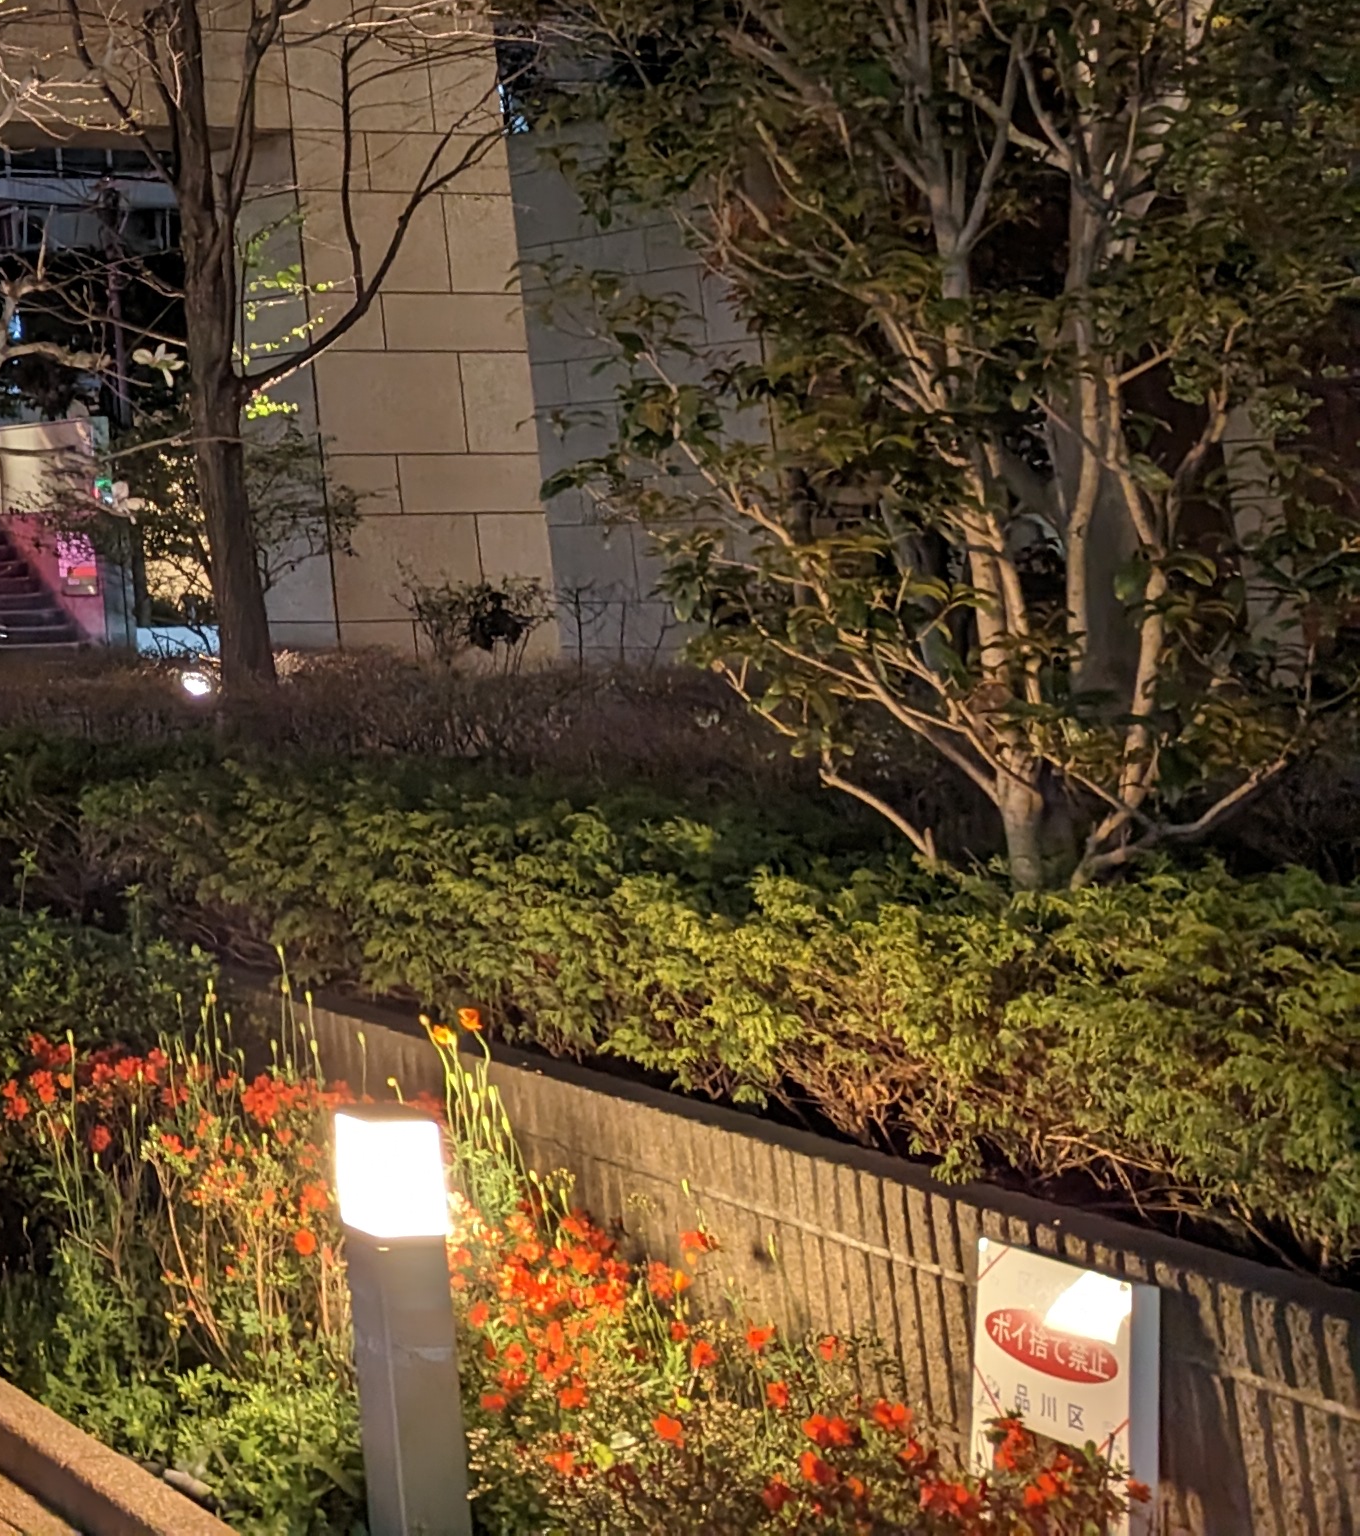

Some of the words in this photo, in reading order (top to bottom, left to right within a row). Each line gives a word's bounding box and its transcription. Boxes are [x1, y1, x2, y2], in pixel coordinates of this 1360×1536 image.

[991, 1312, 1110, 1381] ポイ捨て禁止
[1014, 1383, 1085, 1433] 品川区
